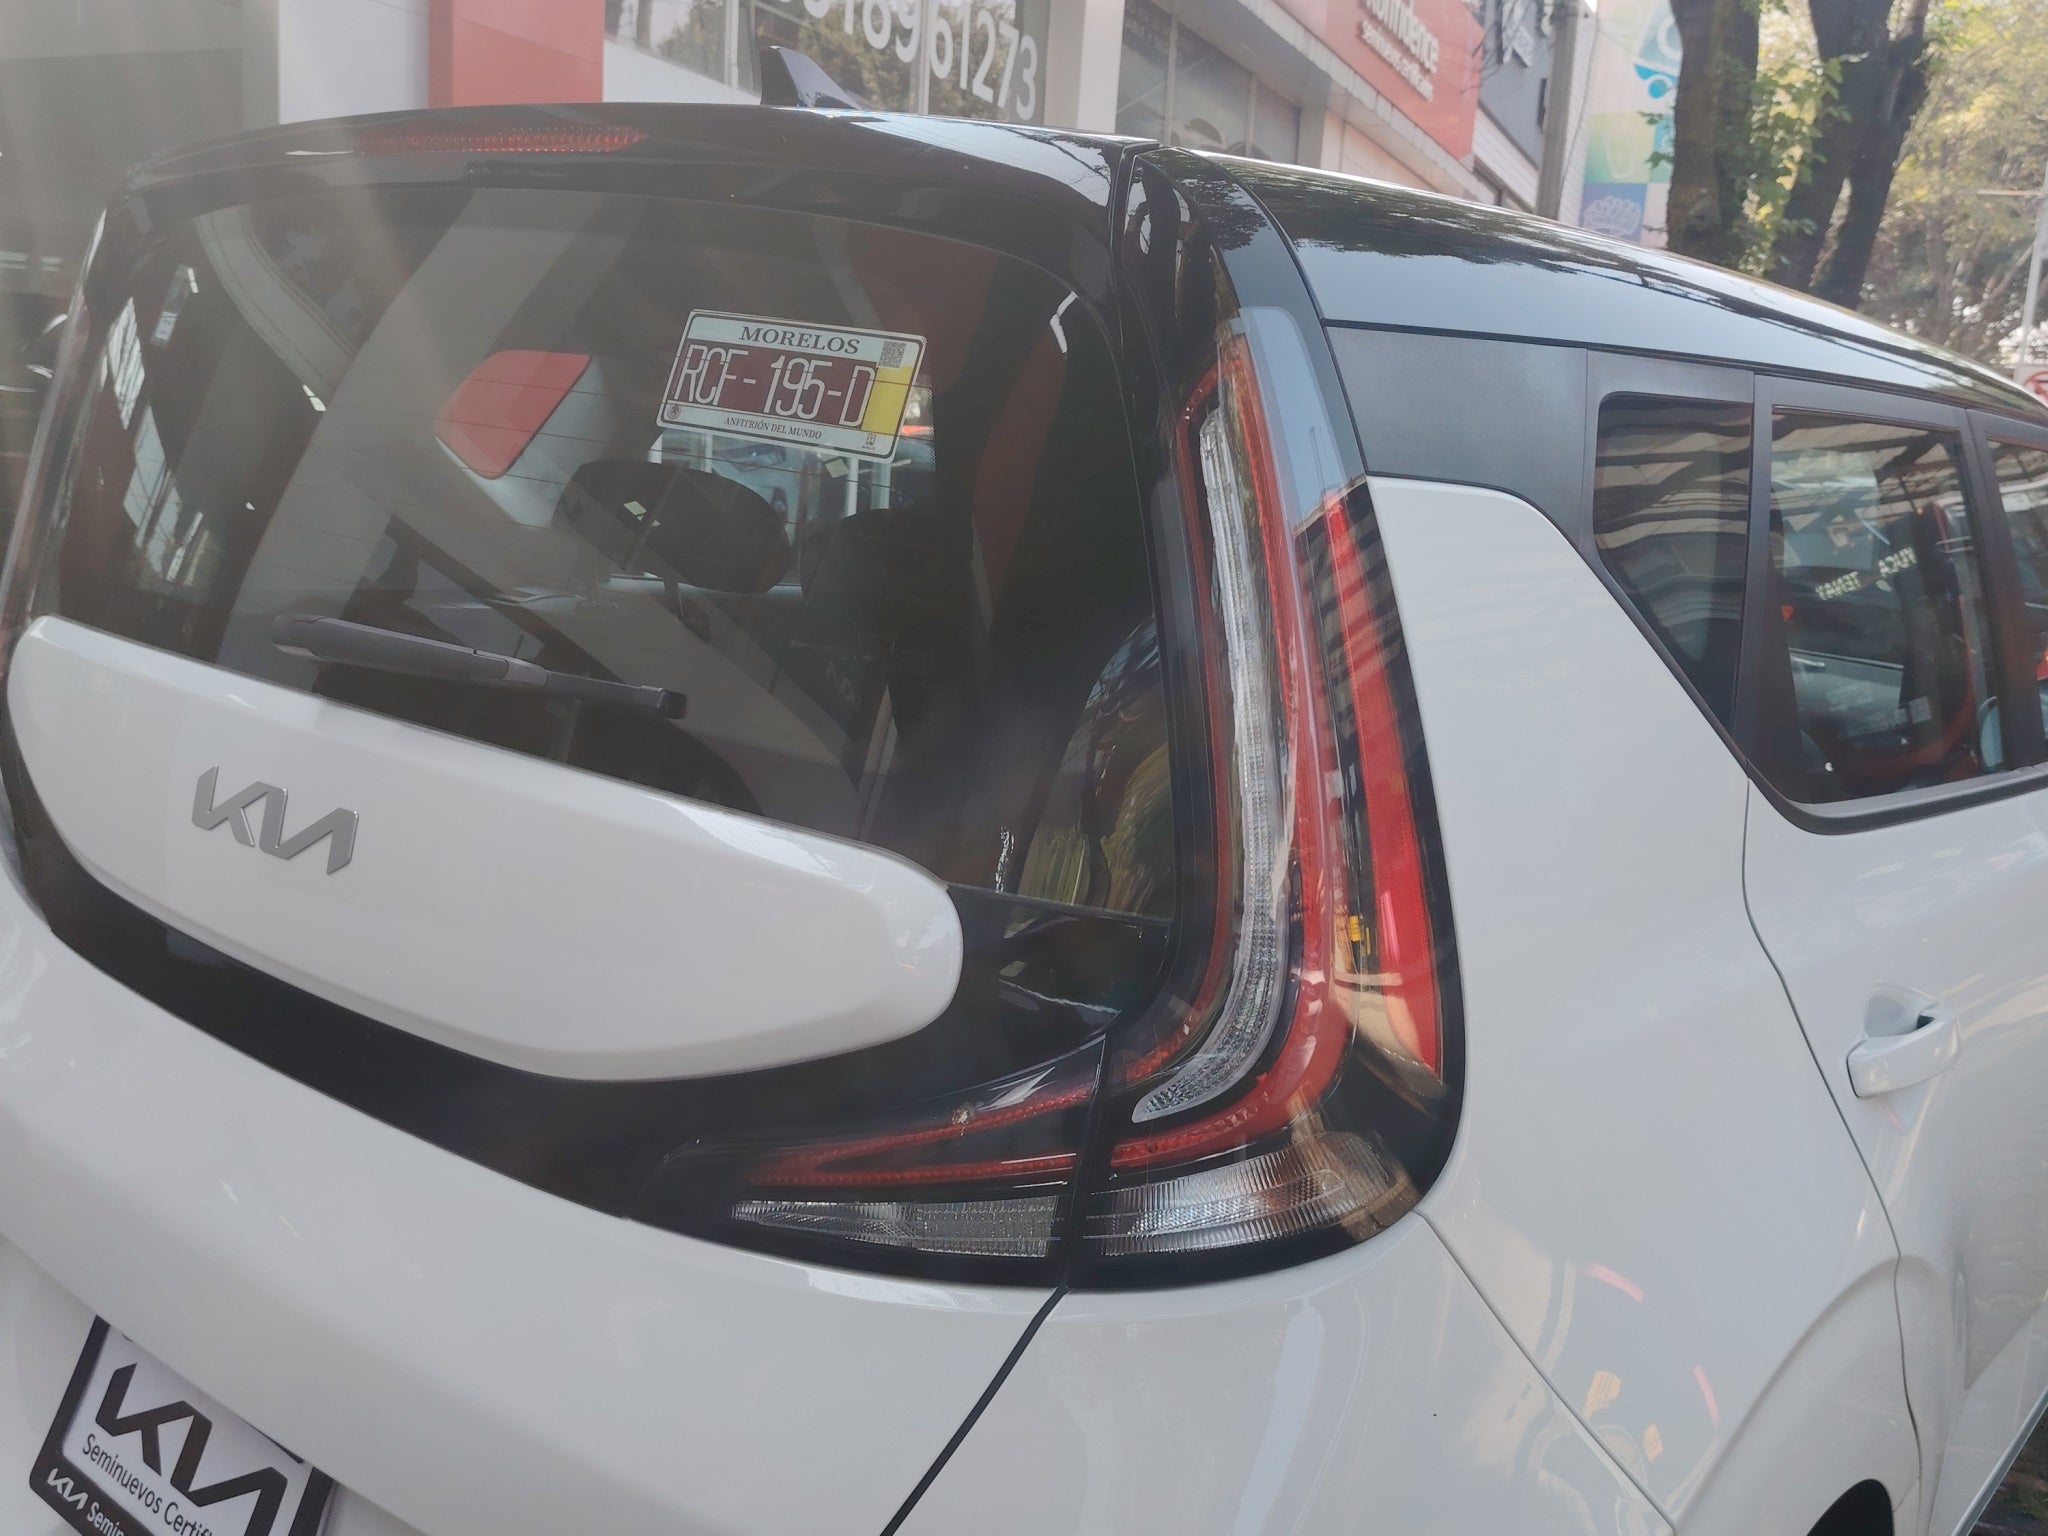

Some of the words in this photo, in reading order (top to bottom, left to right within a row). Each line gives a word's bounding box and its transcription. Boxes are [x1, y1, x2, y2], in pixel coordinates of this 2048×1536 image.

[739, 326, 860, 355] MORELOS
[723, 416, 771, 431] ANFITRIÓN
[770, 422, 789, 435] DEL
[789, 426, 822, 440] MUNDO
[191, 765, 359, 876] KIA
[47, 1468, 89, 1510] KIA
[82, 1433, 163, 1514] Seminuevos
